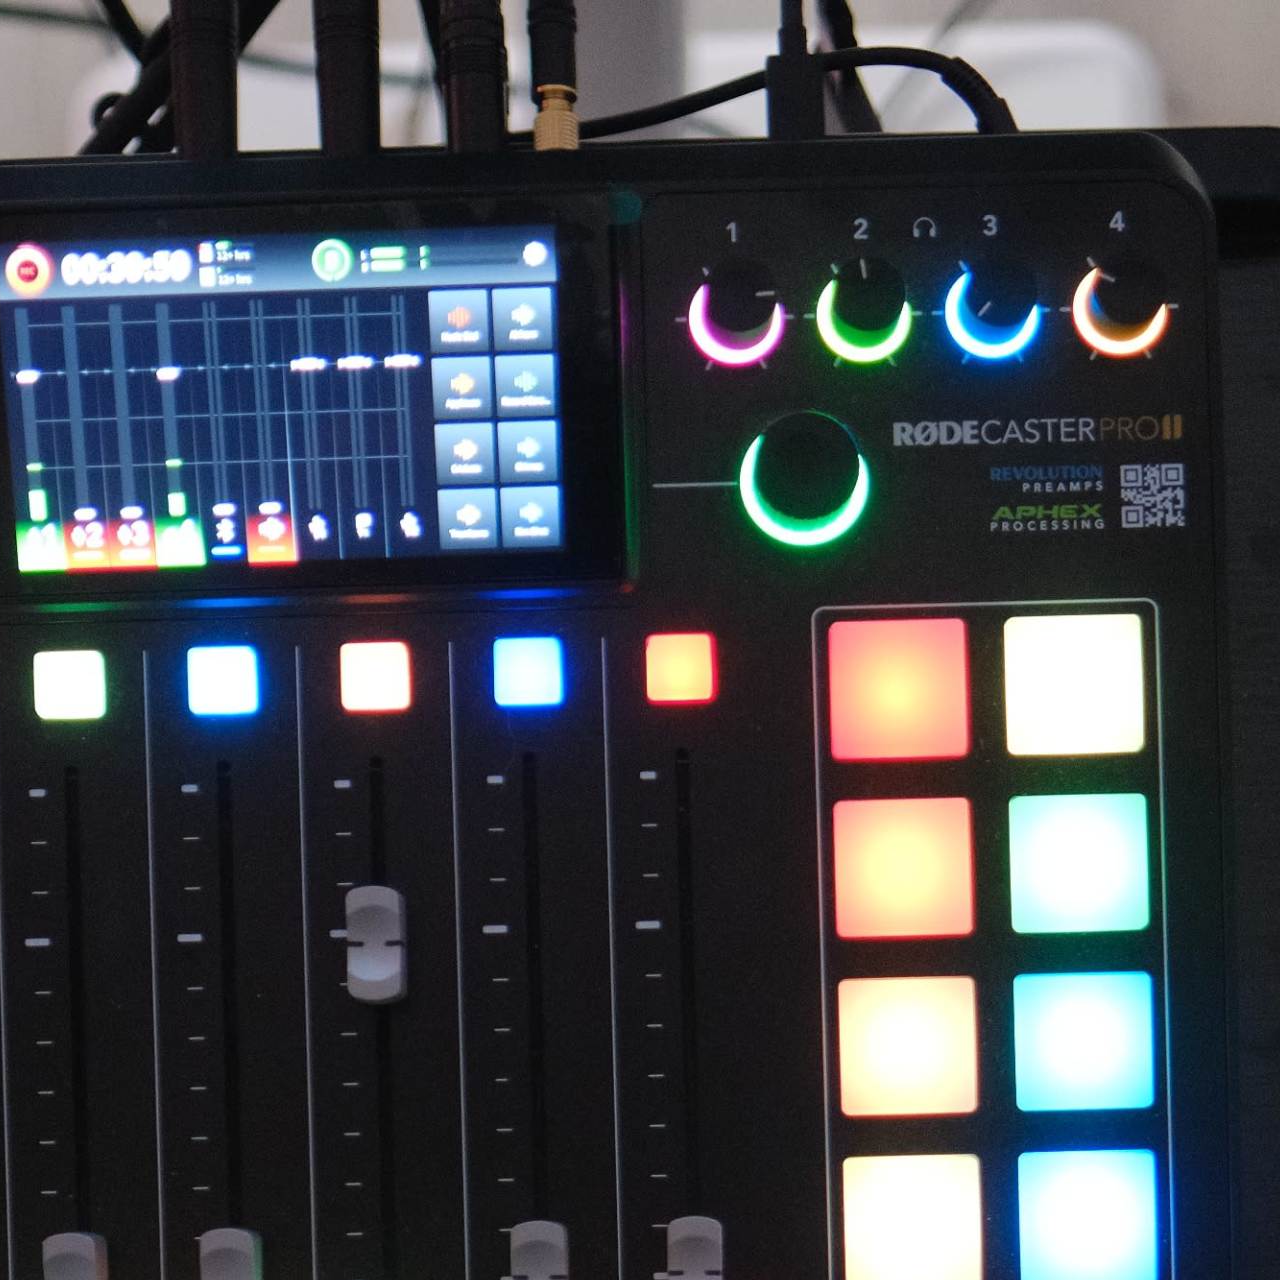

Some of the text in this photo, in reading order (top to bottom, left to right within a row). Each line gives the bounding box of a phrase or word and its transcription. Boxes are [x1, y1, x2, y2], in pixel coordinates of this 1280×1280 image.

[853, 219, 869, 240] 2
[983, 215, 998, 236] 3
[1109, 211, 1125, 232] 4
[726, 222, 737, 242] 1
[990, 465, 1105, 481] REVOLUTION
[1022, 481, 1104, 493] PREAMPS
[992, 504, 1103, 519] APHEX
[990, 519, 1105, 532] PROCESSING
